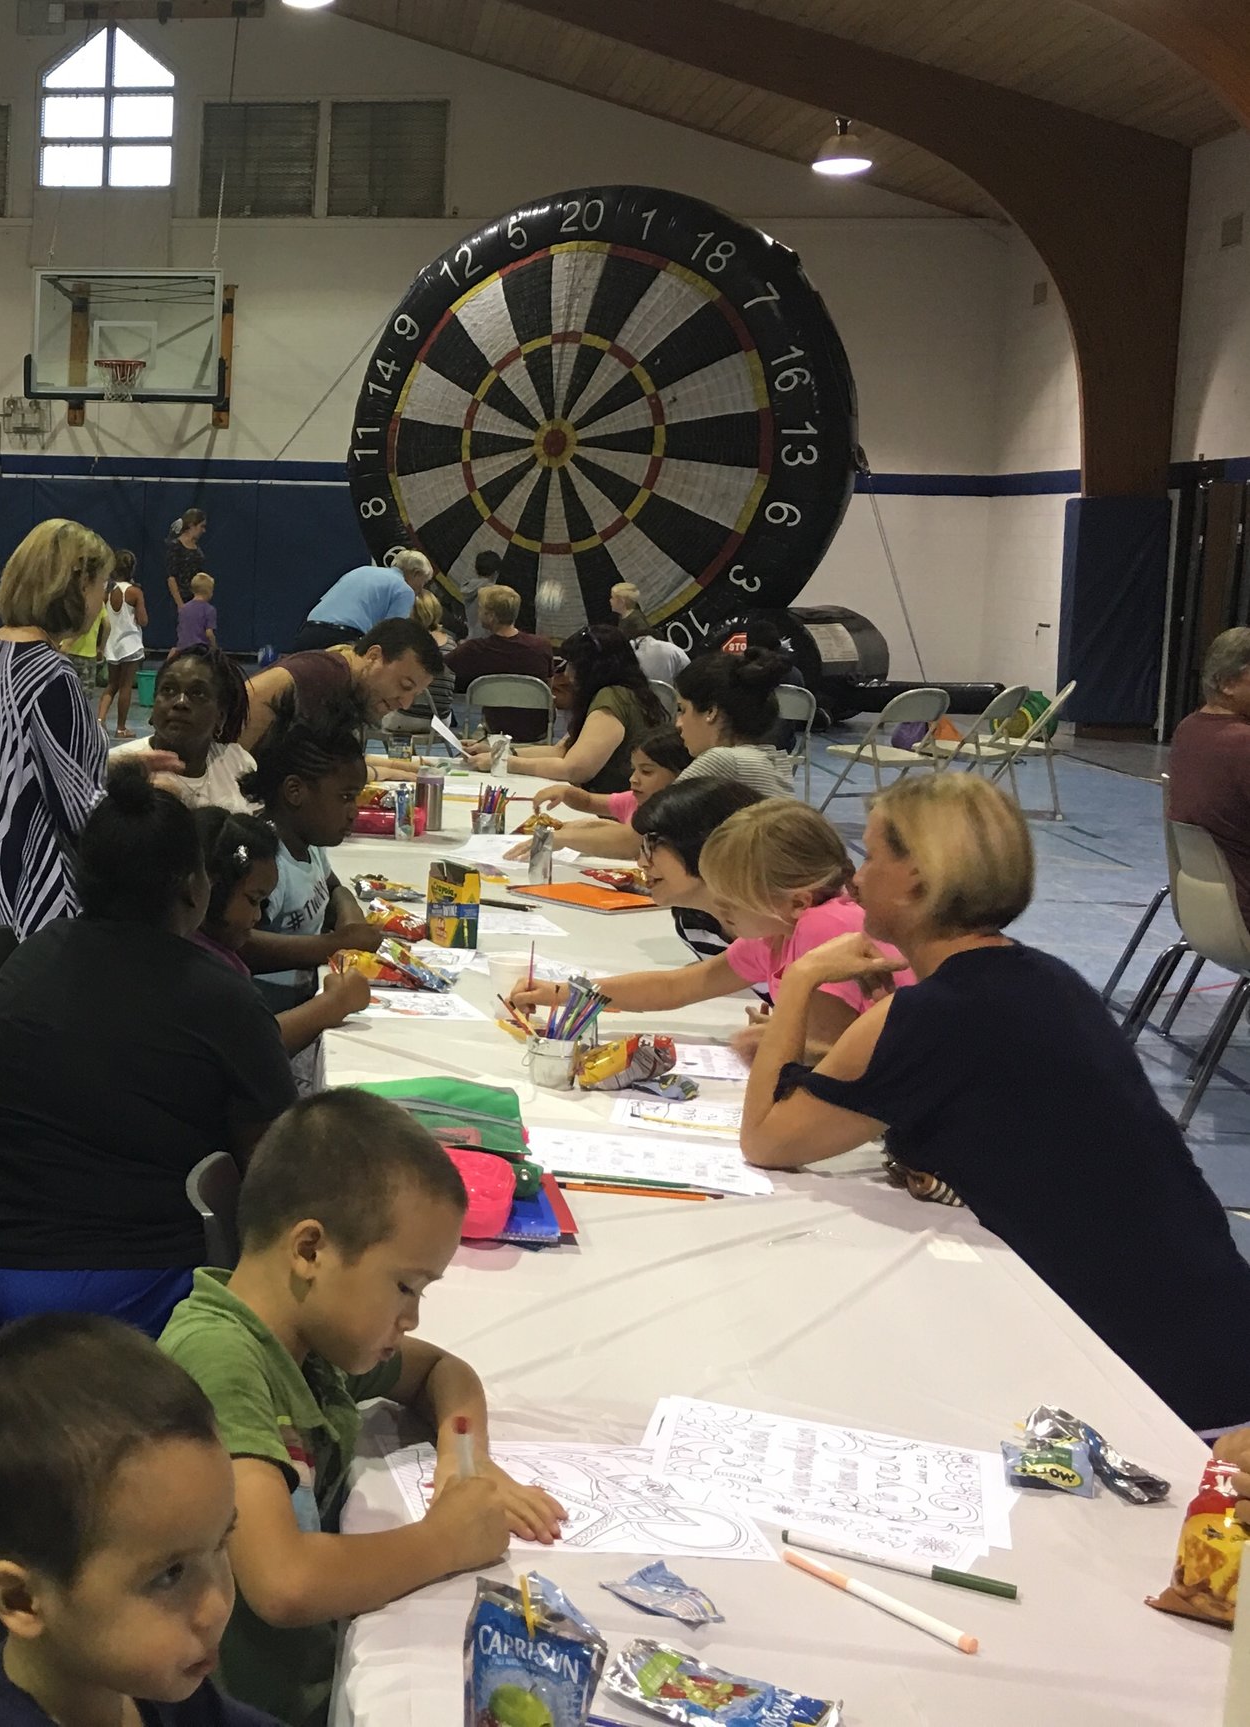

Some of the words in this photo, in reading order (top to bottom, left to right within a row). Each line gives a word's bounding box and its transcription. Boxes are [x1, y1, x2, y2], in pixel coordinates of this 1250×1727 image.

[560, 199, 605, 233] 20
[639, 208, 655, 241] 1
[506, 220, 529, 250] 5
[688, 231, 737, 273] 18
[439, 245, 484, 289] 12
[741, 281, 780, 313] 7
[368, 357, 402, 397] 14
[770, 344, 812, 392] 16
[352, 425, 381, 461] 11
[780, 421, 819, 468] 13
[360, 496, 387, 519] 8
[728, 563, 762, 593] 3
[666, 608, 710, 653] 10
[728, 642, 748, 652] STO
